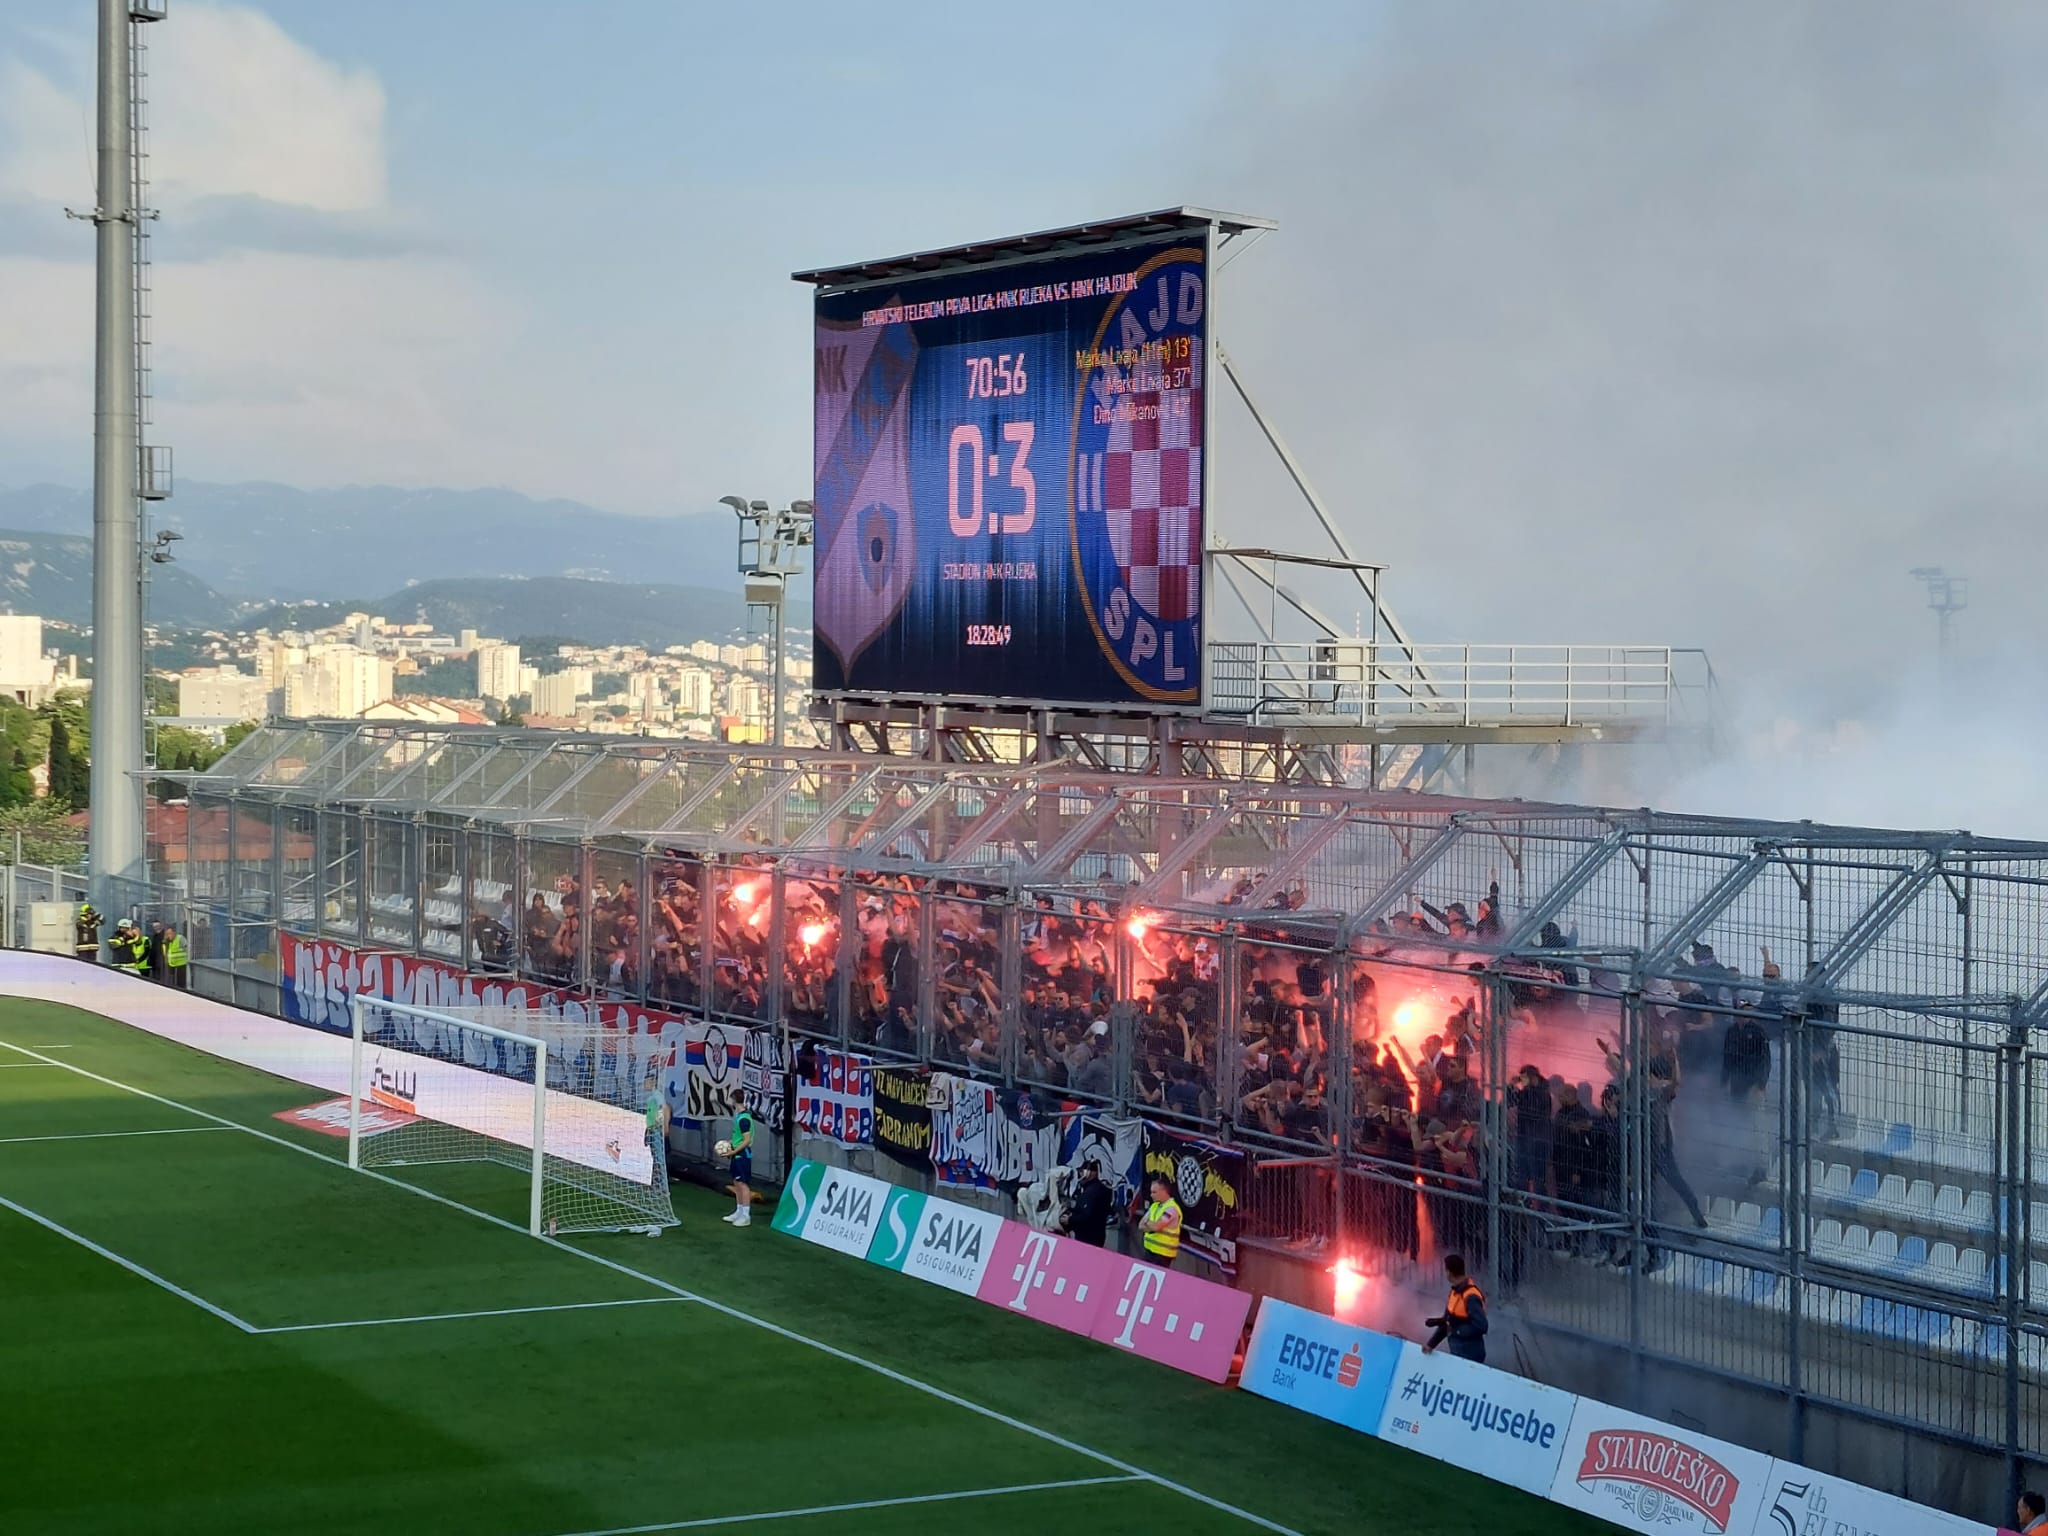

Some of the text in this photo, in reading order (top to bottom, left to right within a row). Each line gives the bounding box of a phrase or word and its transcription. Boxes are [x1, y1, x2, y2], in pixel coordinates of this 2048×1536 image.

[996, 288, 1018, 309] HNK
[1019, 284, 1053, 306] RIJEKA
[1071, 279, 1095, 299] HNK
[1096, 270, 1138, 295] HAJDUK
[966, 352, 1027, 400] 70:56
[948, 421, 1036, 538] 0:3
[943, 563, 981, 580] STADION
[821, 1181, 873, 1227] SAVA
[813, 1219, 865, 1244] OSIGURANJE
[923, 1212, 982, 1263] SAVA
[916, 1252, 976, 1280] OSIGURANJE
[1272, 1368, 1297, 1390] Bank
[1278, 1333, 1339, 1380] ERSTE
[1392, 1416, 1412, 1432] ERSTE
[1401, 1372, 1556, 1449] #vjerujusebe
[1594, 1435, 1727, 1508] STAROČEŠKO
